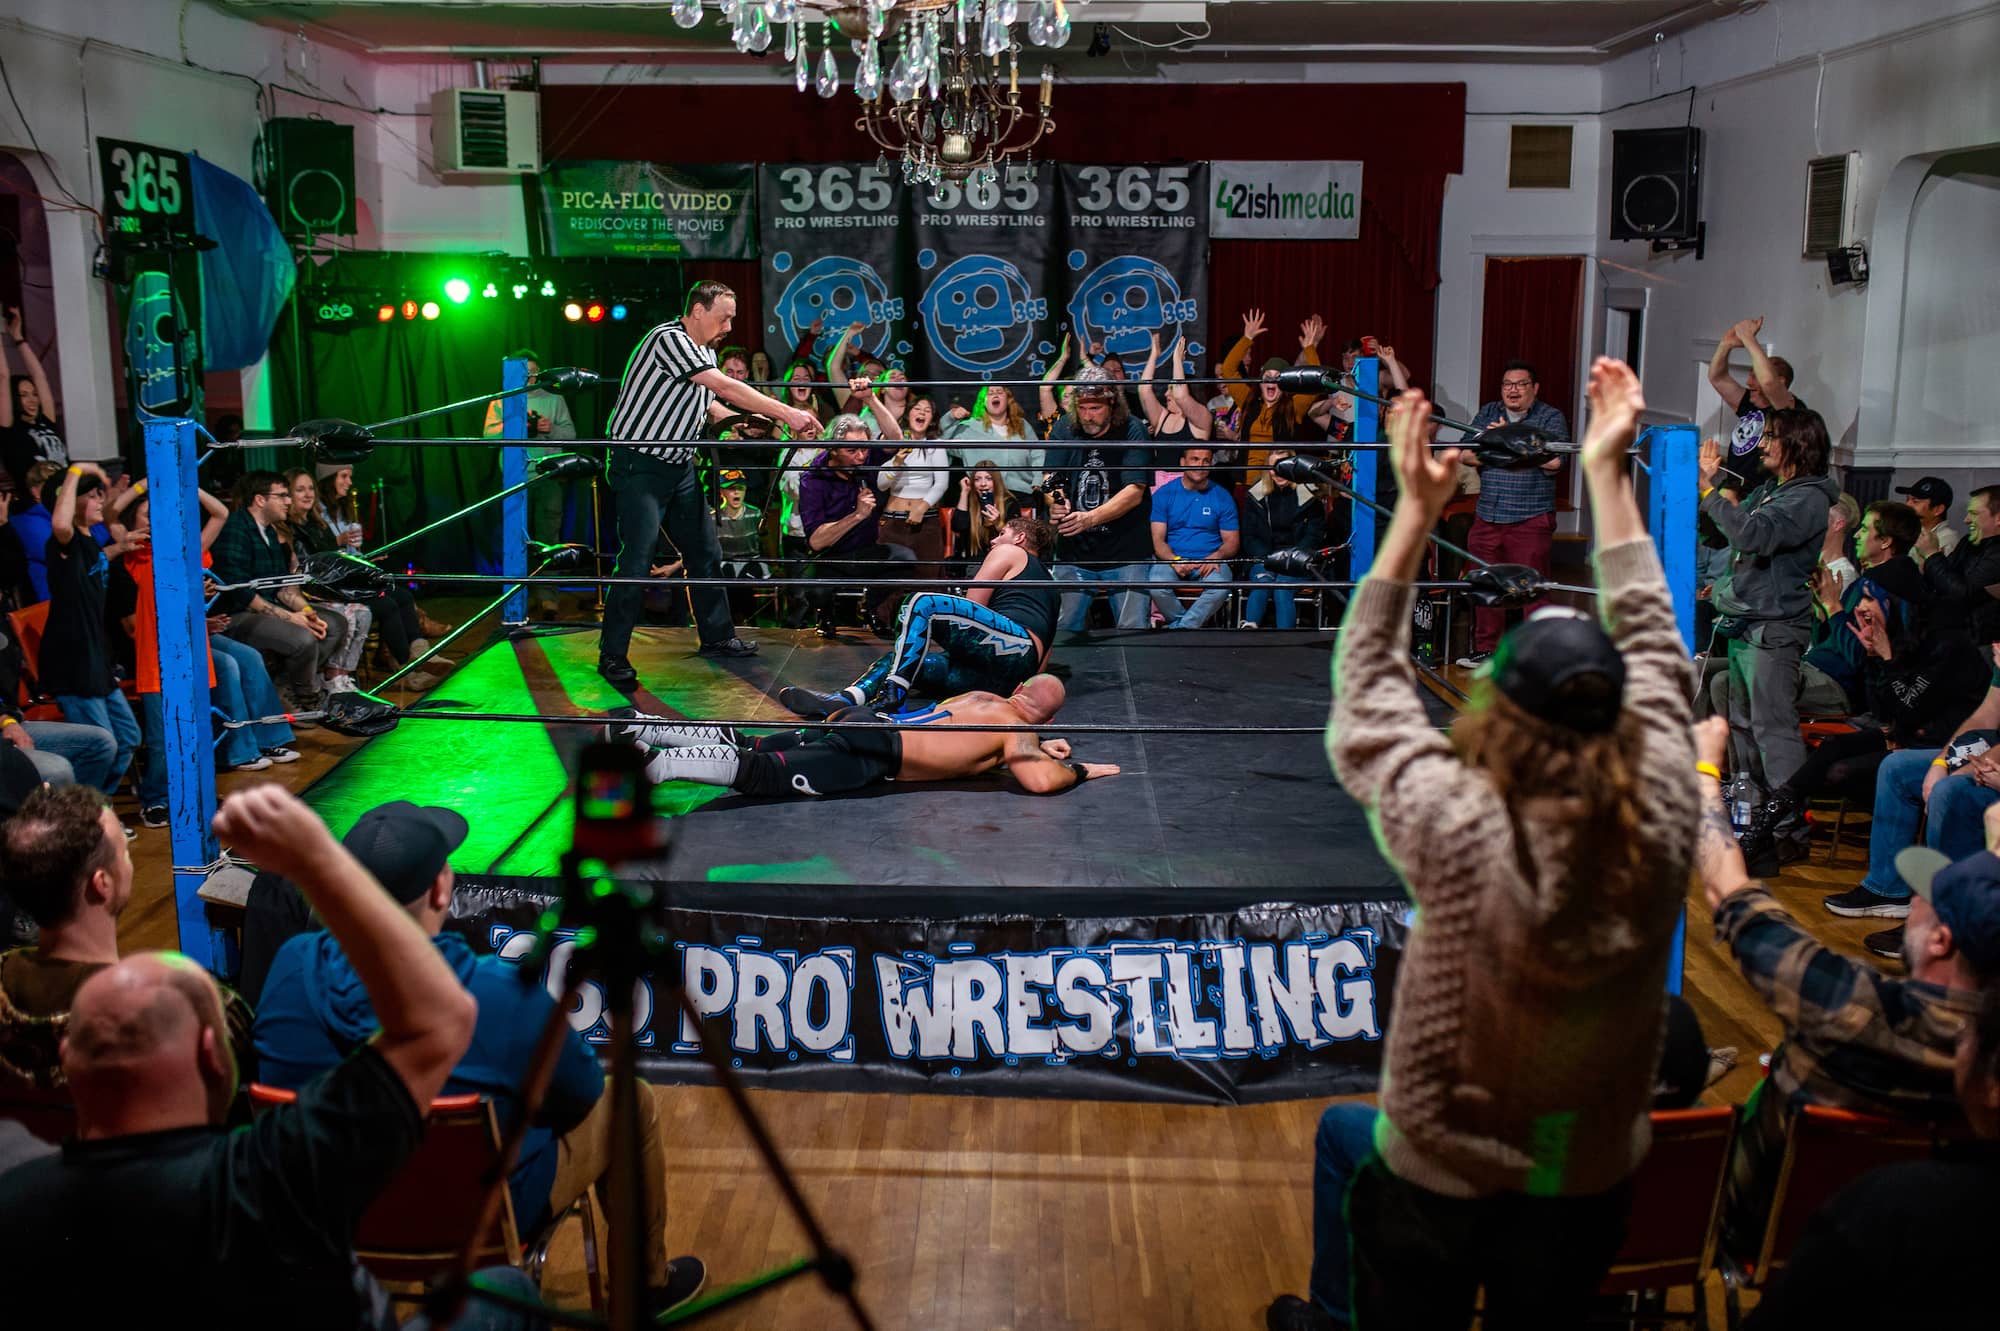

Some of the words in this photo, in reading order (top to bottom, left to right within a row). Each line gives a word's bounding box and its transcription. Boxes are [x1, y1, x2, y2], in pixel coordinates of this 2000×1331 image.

[111, 147, 181, 214] 365
[780, 166, 892, 212] 365
[1078, 166, 1190, 211] 365
[562, 192, 665, 210] PIC-A-FLIC
[668, 193, 732, 211] VIDEO
[1216, 179, 1354, 219] 42ishmedia
[570, 217, 648, 231] REDISCOVER
[652, 218, 673, 231] THE
[678, 218, 725, 232] MOVIES
[775, 217, 806, 228] PRO
[809, 215, 899, 228] WRESTLING
[920, 214, 951, 226] PRO
[955, 215, 1045, 226] WRESTLING
[1071, 215, 1102, 227] PRO
[1106, 215, 1196, 228] WRESTLING
[870, 297, 905, 324] 365
[1013, 297, 1048, 323] 365
[1163, 299, 1198, 324] 365
[678, 945, 850, 1052] PRO
[875, 940, 1380, 1058] WRESTLING
